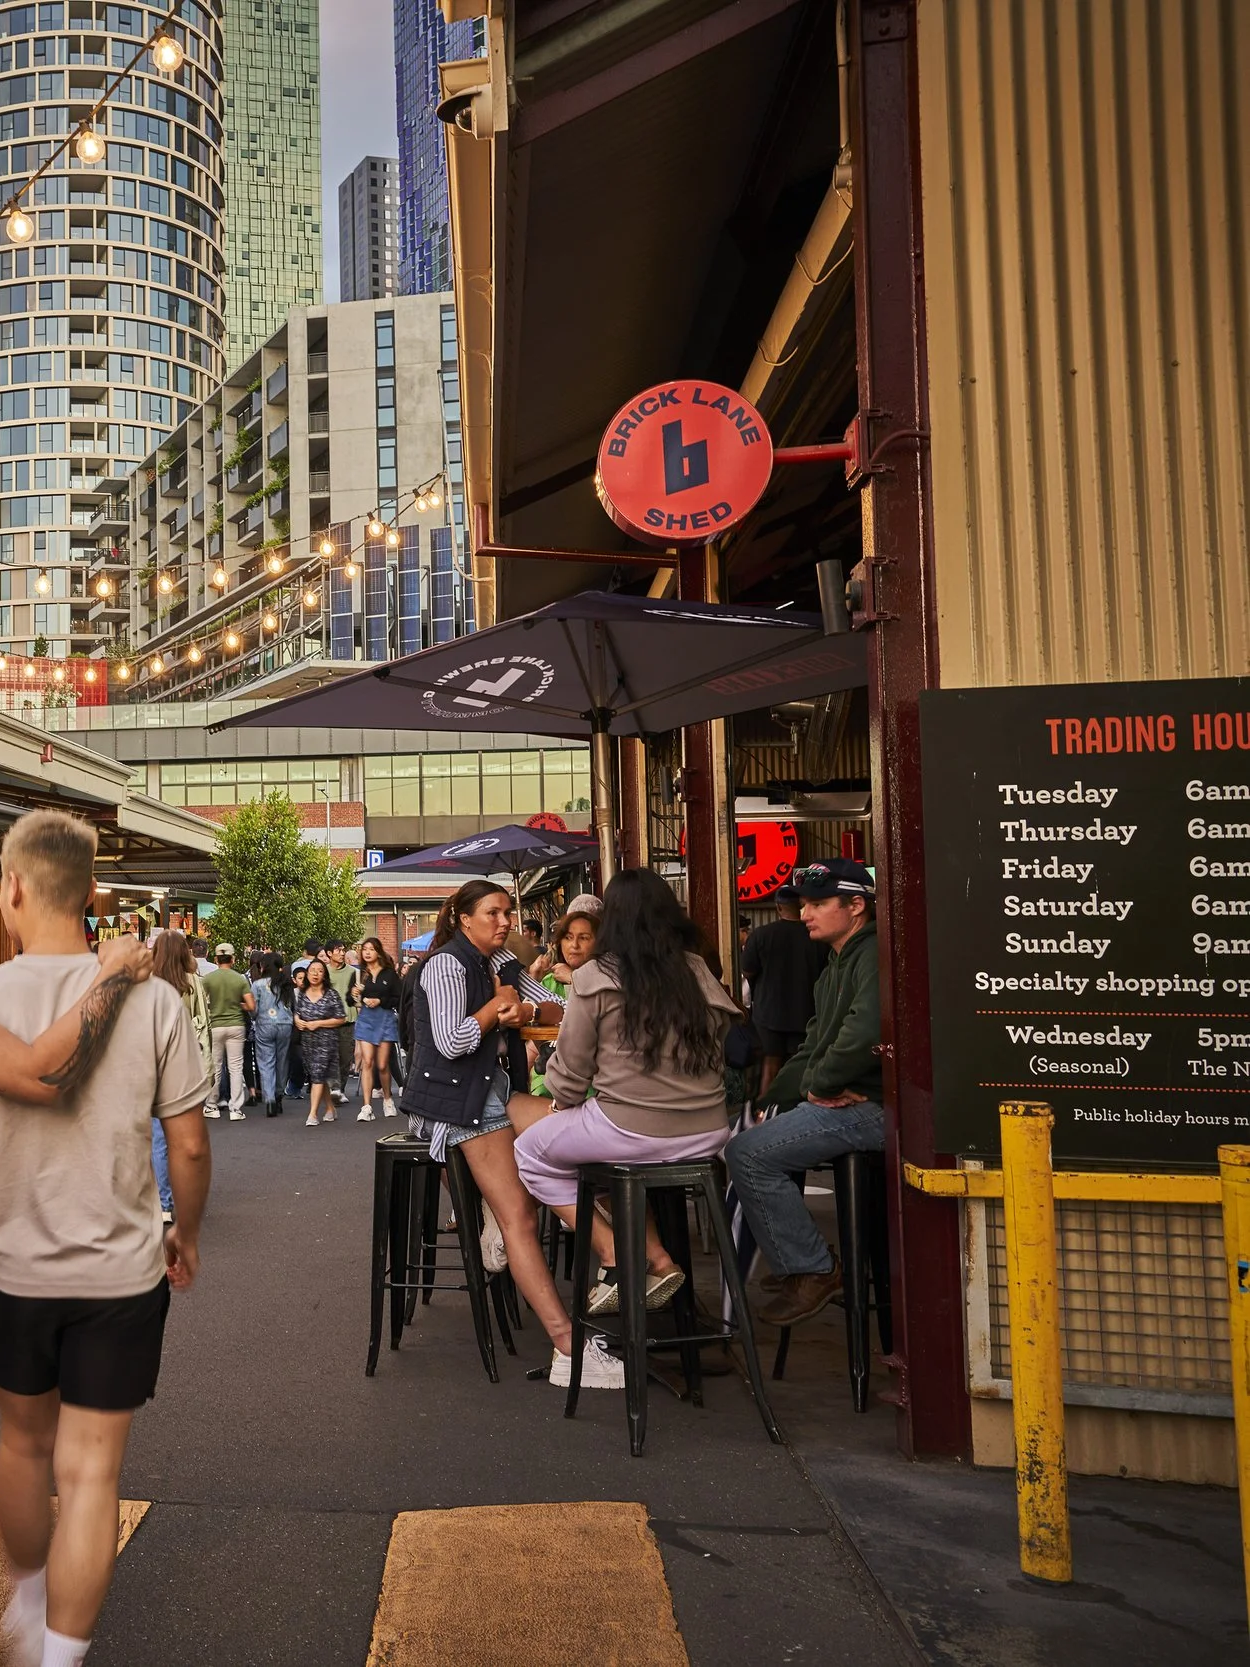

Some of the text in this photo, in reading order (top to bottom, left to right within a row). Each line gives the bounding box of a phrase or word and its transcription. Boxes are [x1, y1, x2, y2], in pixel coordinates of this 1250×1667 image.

[607, 387, 762, 458] BRICK LANE
[643, 501, 732, 531] SHED
[1045, 714, 1176, 755] TRADING
[998, 780, 1250, 808] Tuesday 6am
[1000, 818, 1250, 846] Thursday 6am
[1002, 856, 1250, 884] Friday 6am
[1003, 894, 1250, 921] Saturday 6am
[1005, 932, 1111, 959] Sunday
[975, 971, 1089, 996] Specialty
[1096, 973, 1215, 997] shopping
[1006, 1025, 1151, 1051] Wednesday
[1028, 1056, 1130, 1077] (Seasonal)
[1187, 1059, 1227, 1076] The
[1073, 1108, 1121, 1123] Public
[1125, 1109, 1181, 1126] holiday
[1185, 1111, 1229, 1125] hours
